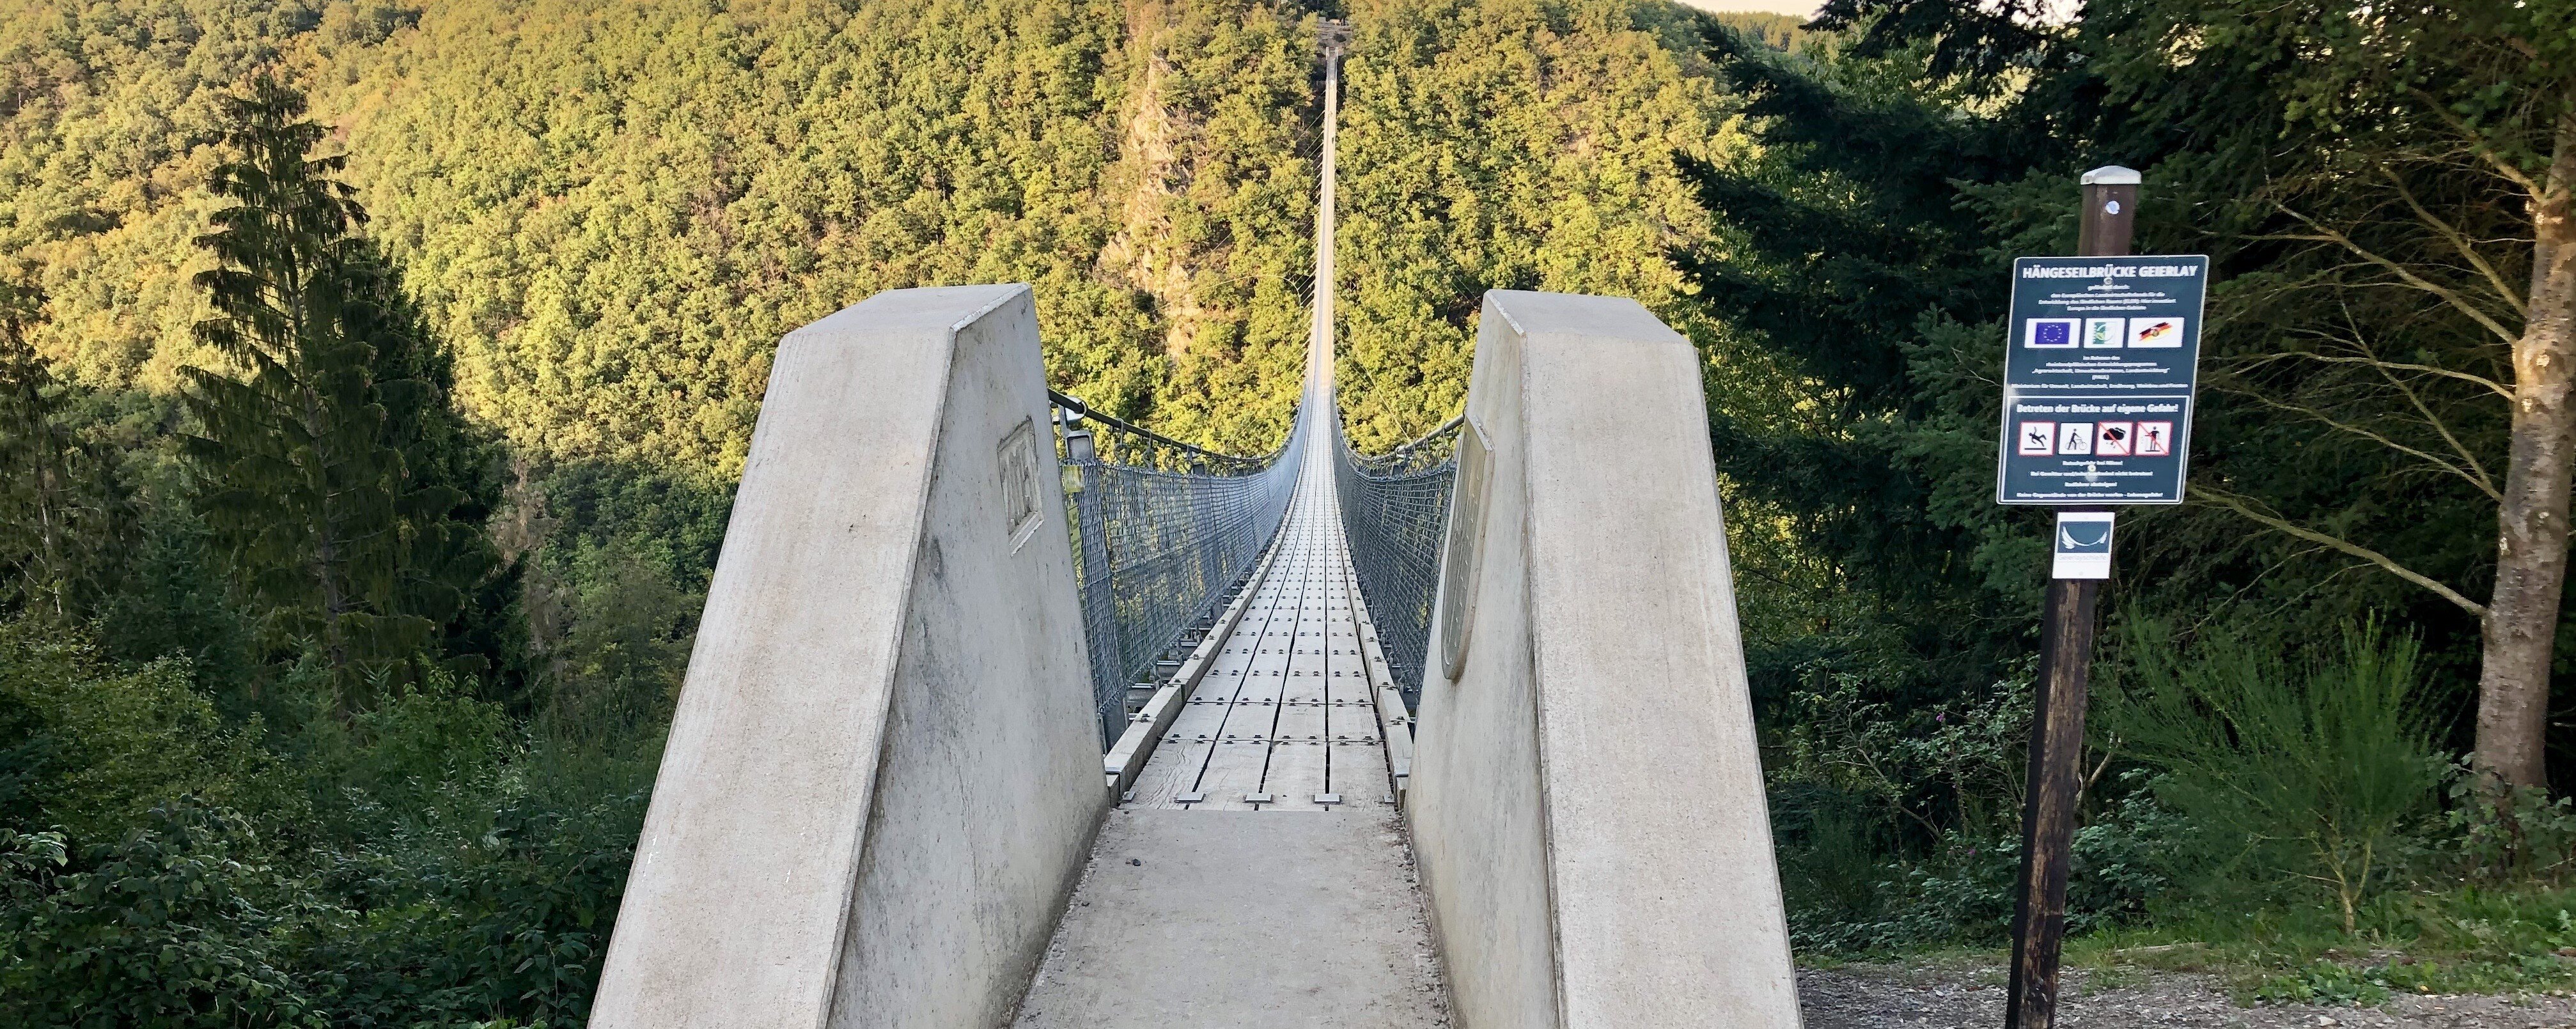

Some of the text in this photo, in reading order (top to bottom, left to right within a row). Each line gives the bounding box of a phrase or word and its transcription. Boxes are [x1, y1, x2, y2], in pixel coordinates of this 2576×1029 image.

[2022, 264, 2198, 278] HÄNGESEILBRÜCKE GEIERLAY
[2017, 404, 2054, 413] Betreten
[2055, 404, 2070, 413] der
[2072, 404, 2100, 413] Brücke
[2102, 403, 2117, 413] auf
[2117, 404, 2146, 415] eigene
